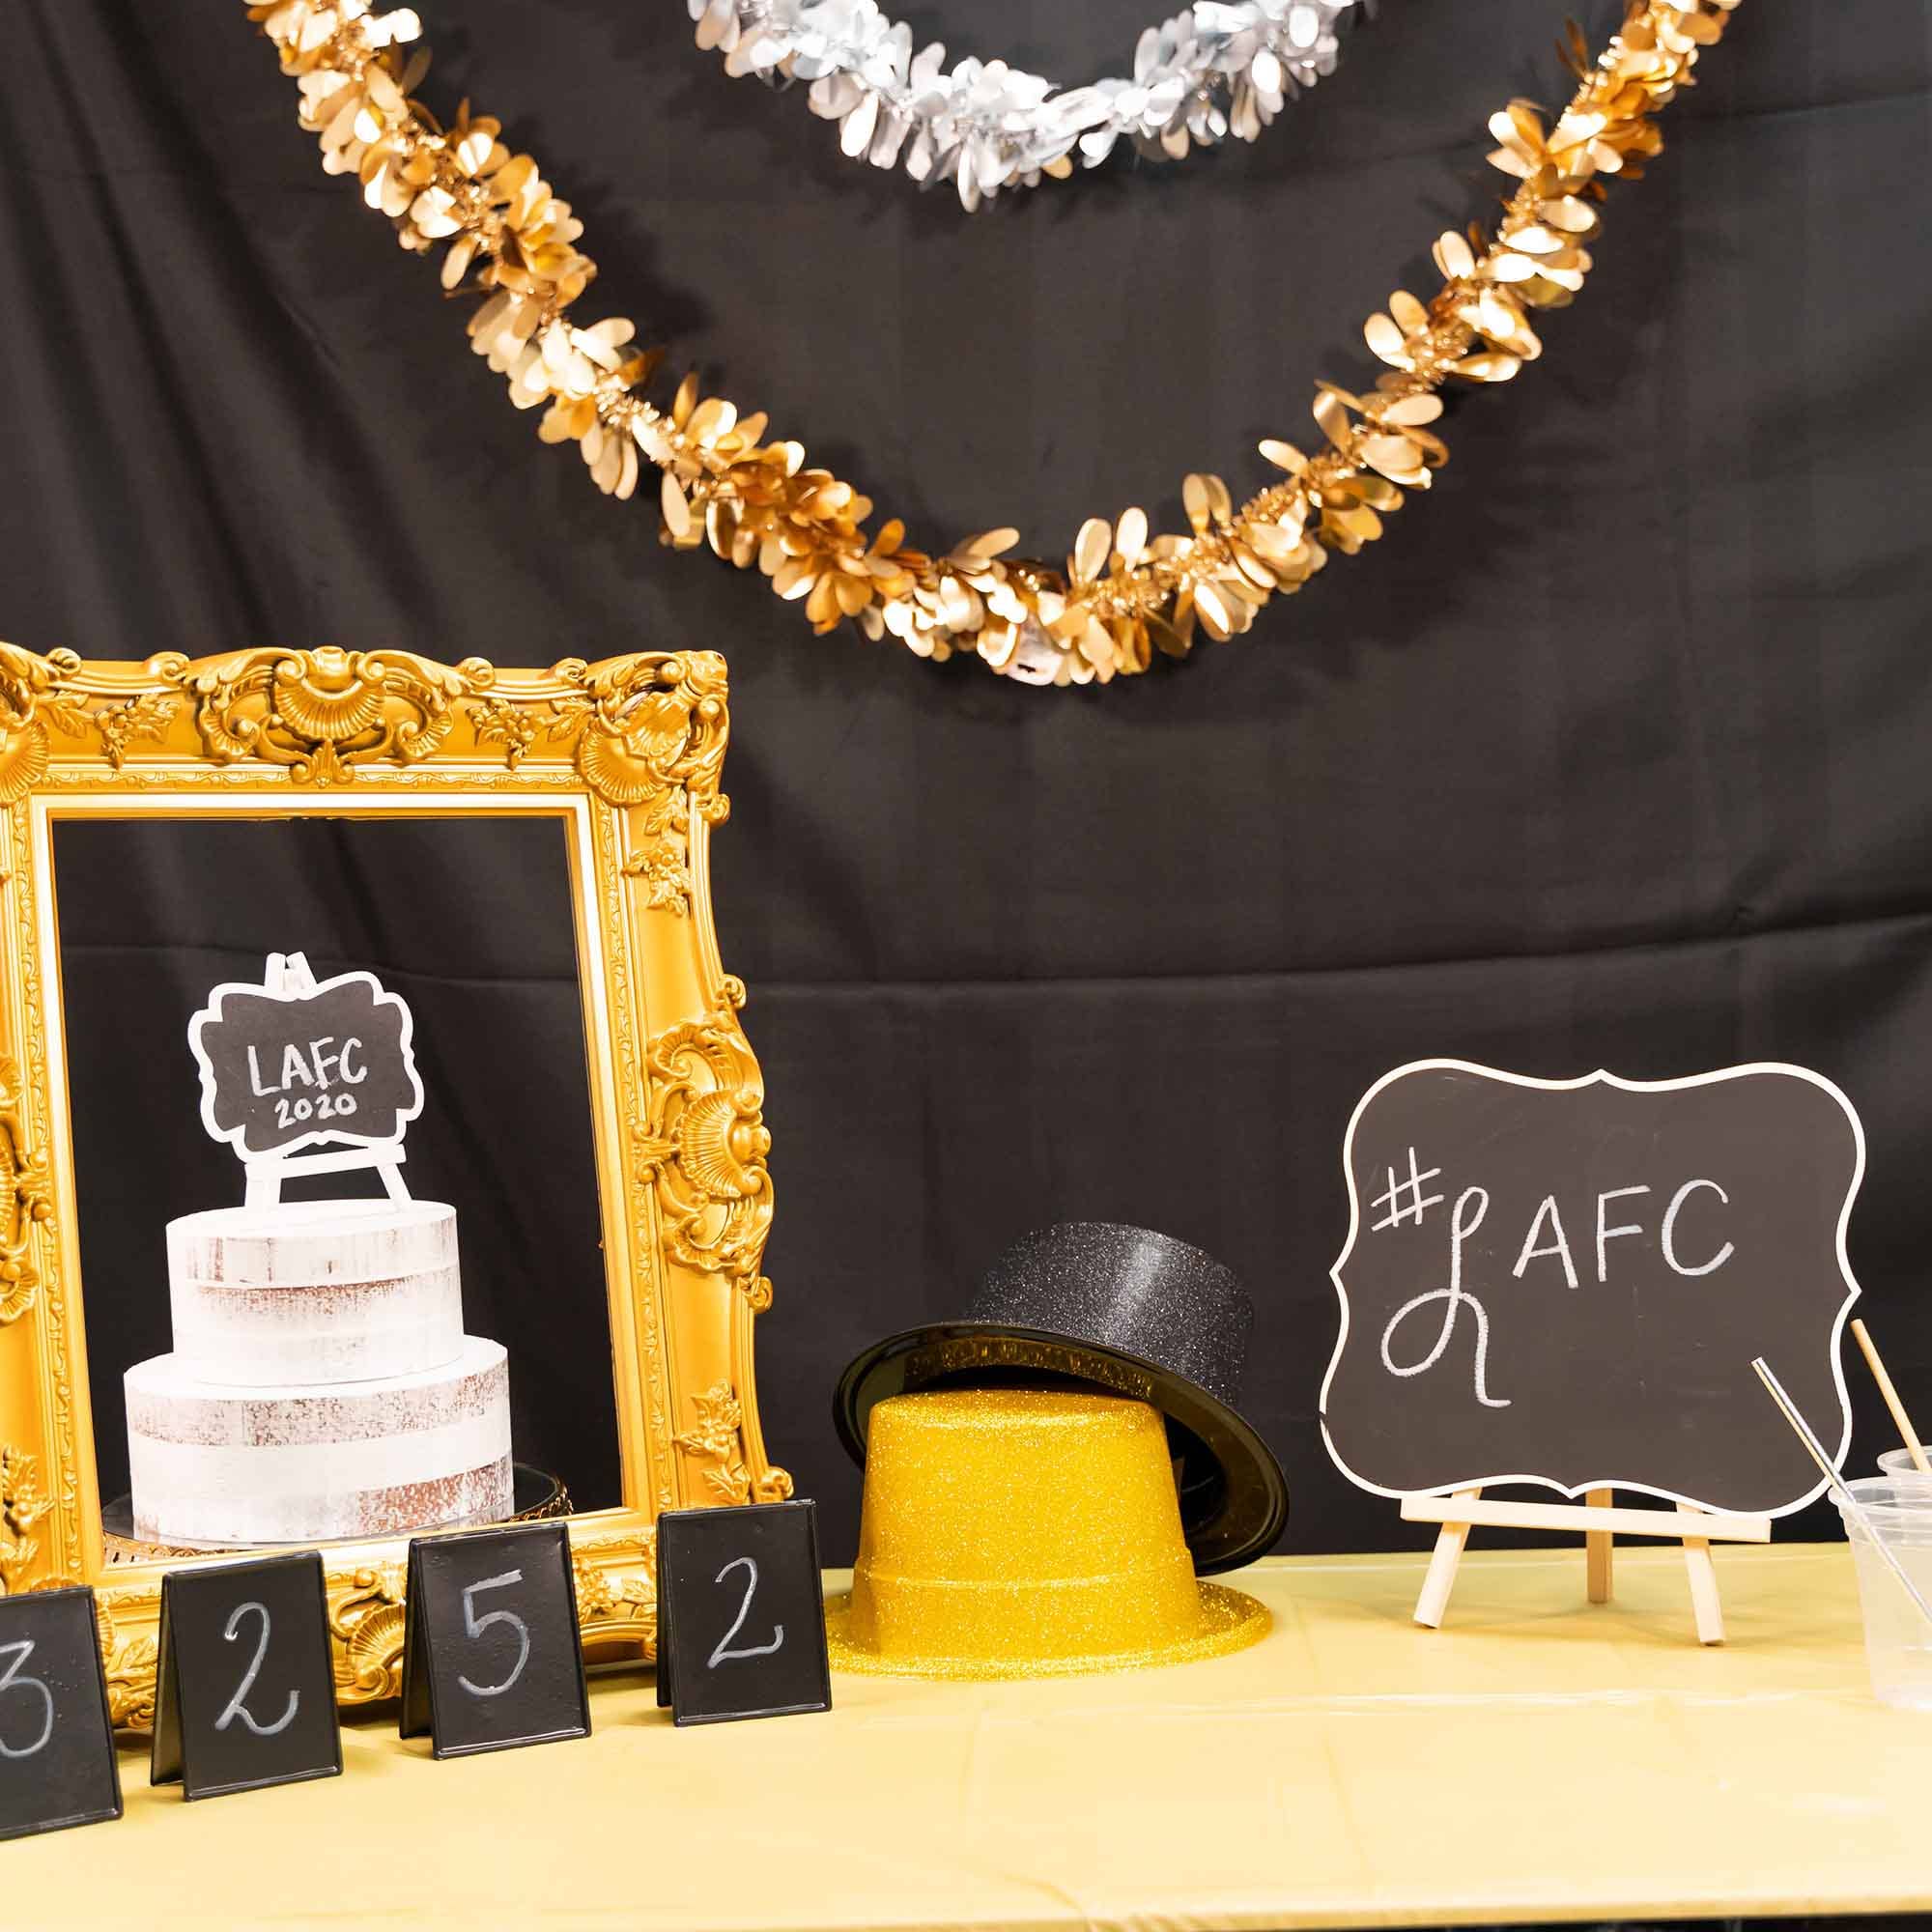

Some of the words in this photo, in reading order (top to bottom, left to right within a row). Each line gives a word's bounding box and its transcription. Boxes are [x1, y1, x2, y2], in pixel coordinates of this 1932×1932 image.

[246, 1037, 367, 1096] LAFC
[274, 1093, 357, 1128] 2020
[1370, 1146, 1735, 1407] #LAFC
[214, 1601, 299, 1736] 2
[458, 1569, 530, 1696] 5
[706, 1556, 784, 1669] 2
[0, 1638, 54, 1759] 3
